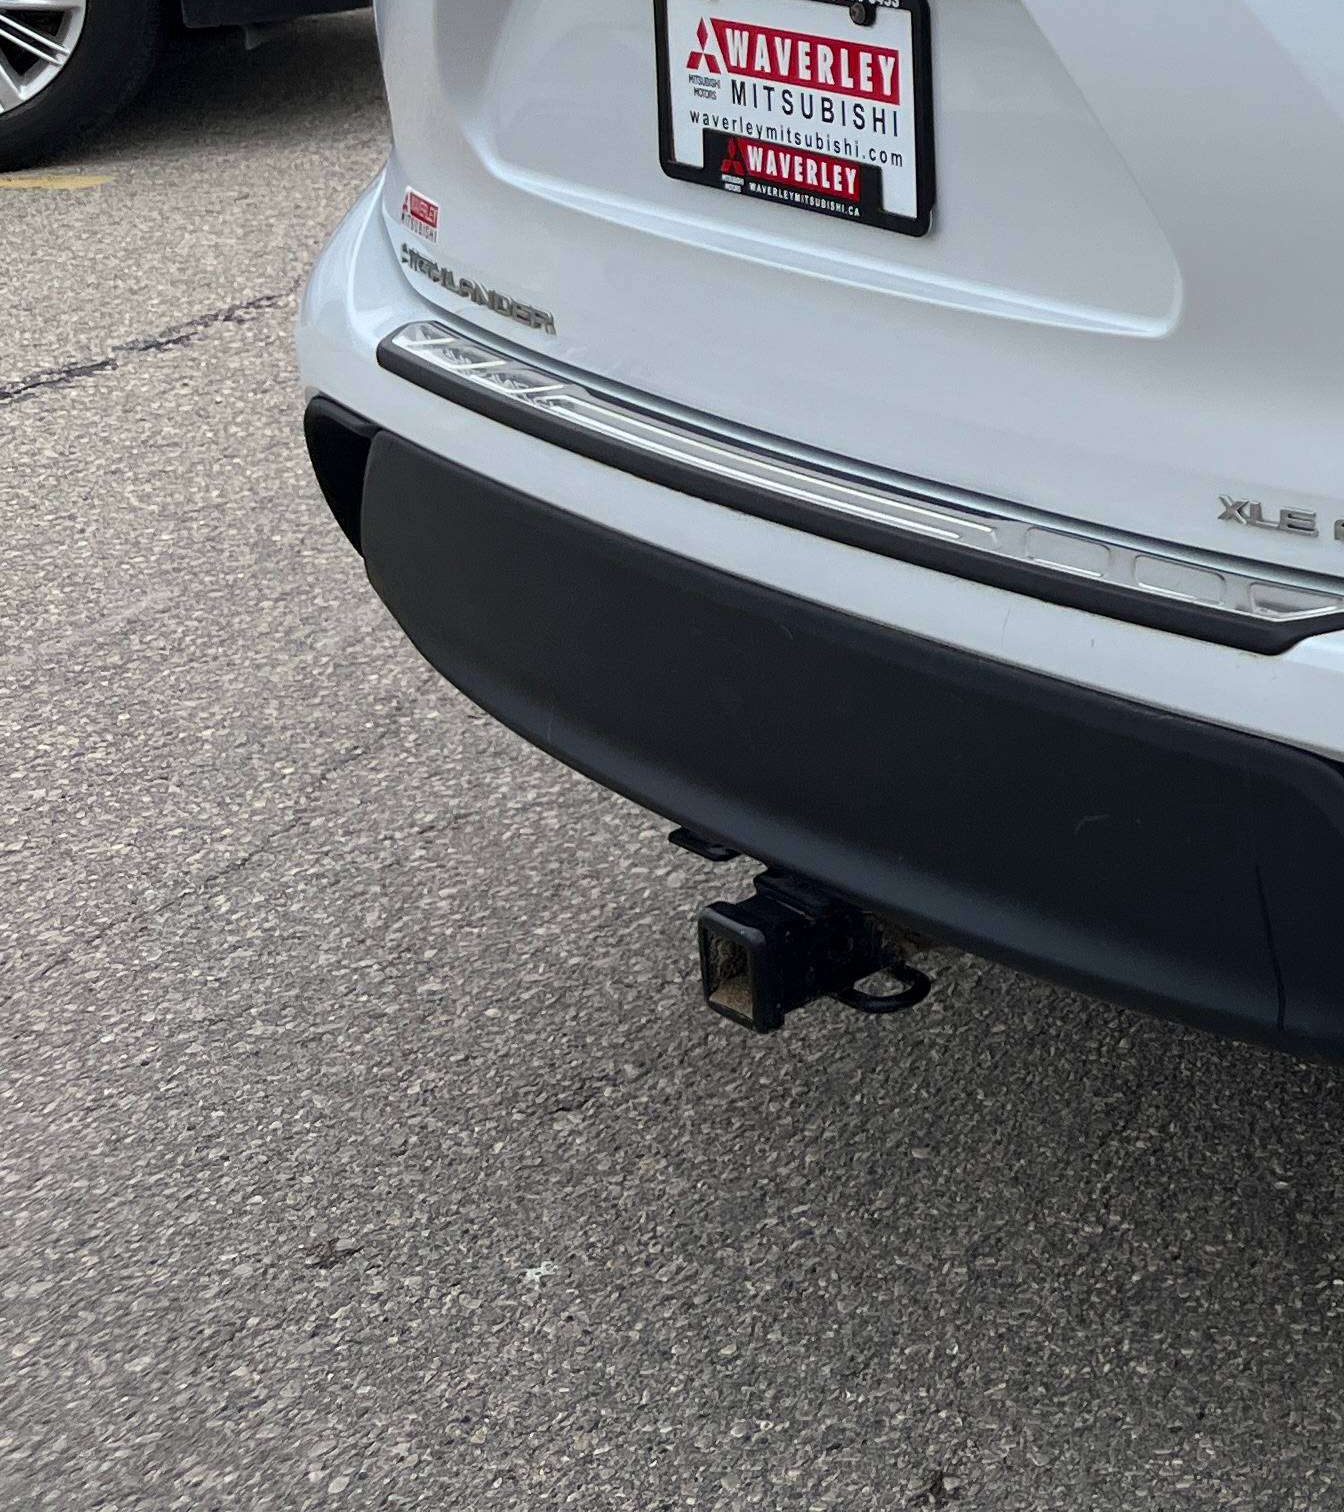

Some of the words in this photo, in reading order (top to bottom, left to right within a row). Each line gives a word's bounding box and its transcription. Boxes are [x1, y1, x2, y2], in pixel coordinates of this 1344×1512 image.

[725, 27, 896, 97] WAVERLEY
[731, 79, 899, 137] MITSUBISHI
[689, 108, 903, 167] waverleymitsubishi.com
[746, 144, 857, 195] WAVERLEY
[749, 181, 861, 217] WAVERLEYMITSUBISHI.CA
[1217, 495, 1320, 538] XLE
